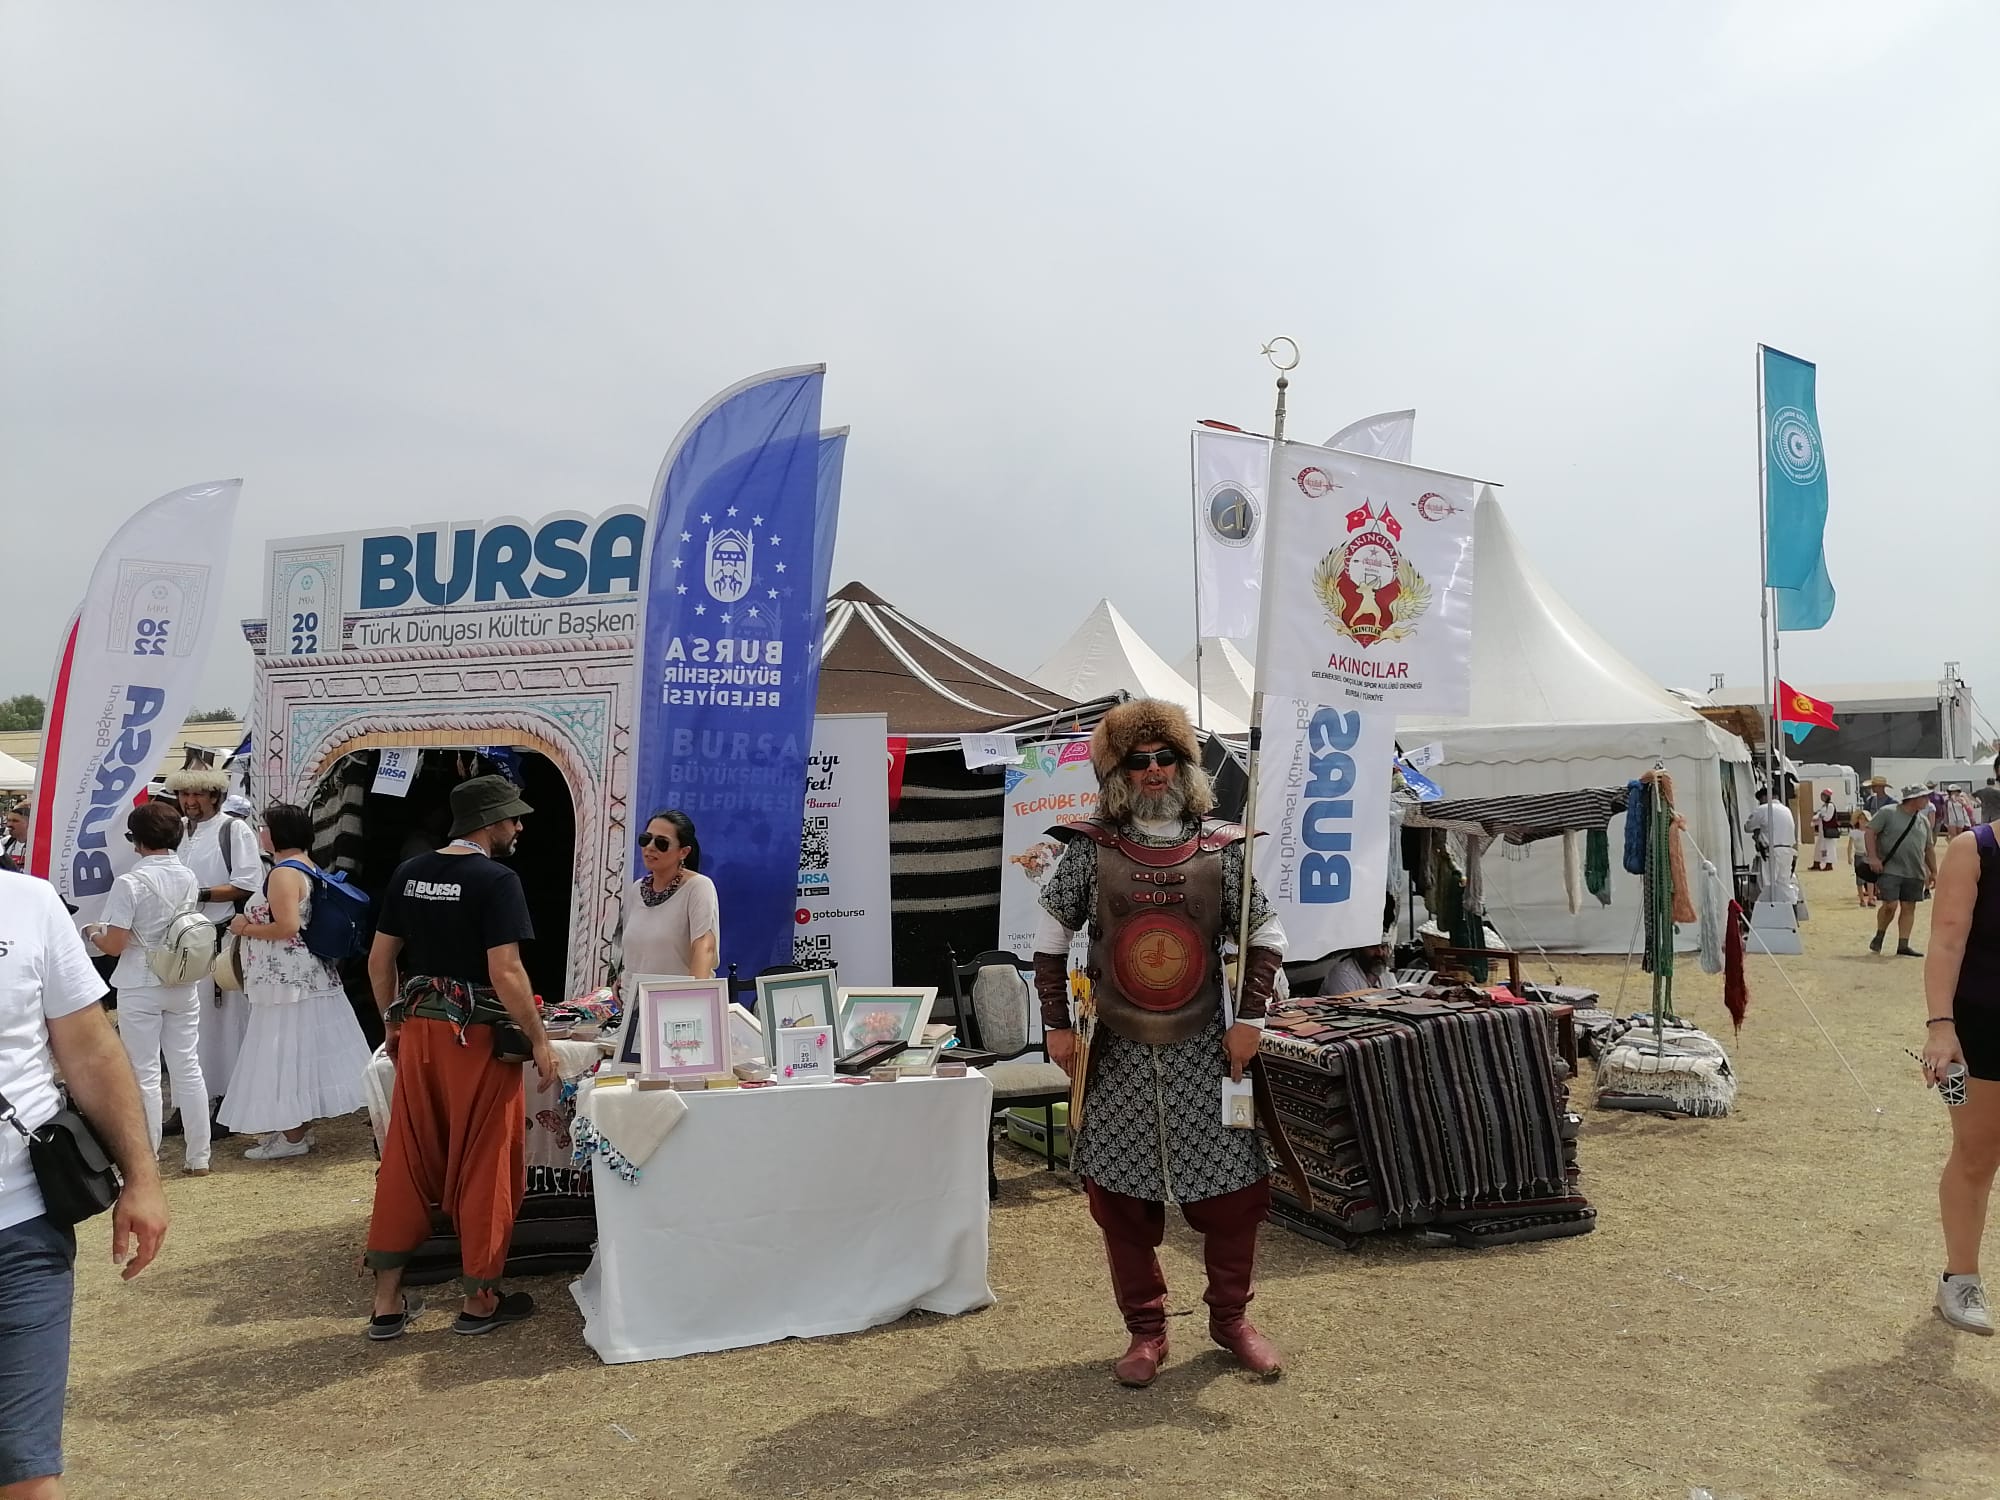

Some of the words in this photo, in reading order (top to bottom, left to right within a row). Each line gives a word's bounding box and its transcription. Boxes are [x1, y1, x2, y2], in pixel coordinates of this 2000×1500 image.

[360, 513, 647, 609] BURSA
[292, 612, 318, 633] 20
[359, 618, 401, 646] Türk
[406, 618, 483, 648] Dünyası
[488, 612, 553, 639] Kültür
[558, 608, 637, 640] Başken
[291, 634, 318, 655] 22
[1327, 653, 1409, 679] AKINCILAR
[378, 766, 407, 780] URSA
[807, 750, 841, 773] a'yı
[804, 771, 834, 794] fet!
[806, 797, 842, 809] Bursa!
[1012, 793, 1077, 817] TECRÜBE
[1080, 792, 1099, 808] PA
[812, 908, 865, 921] gotobursa
